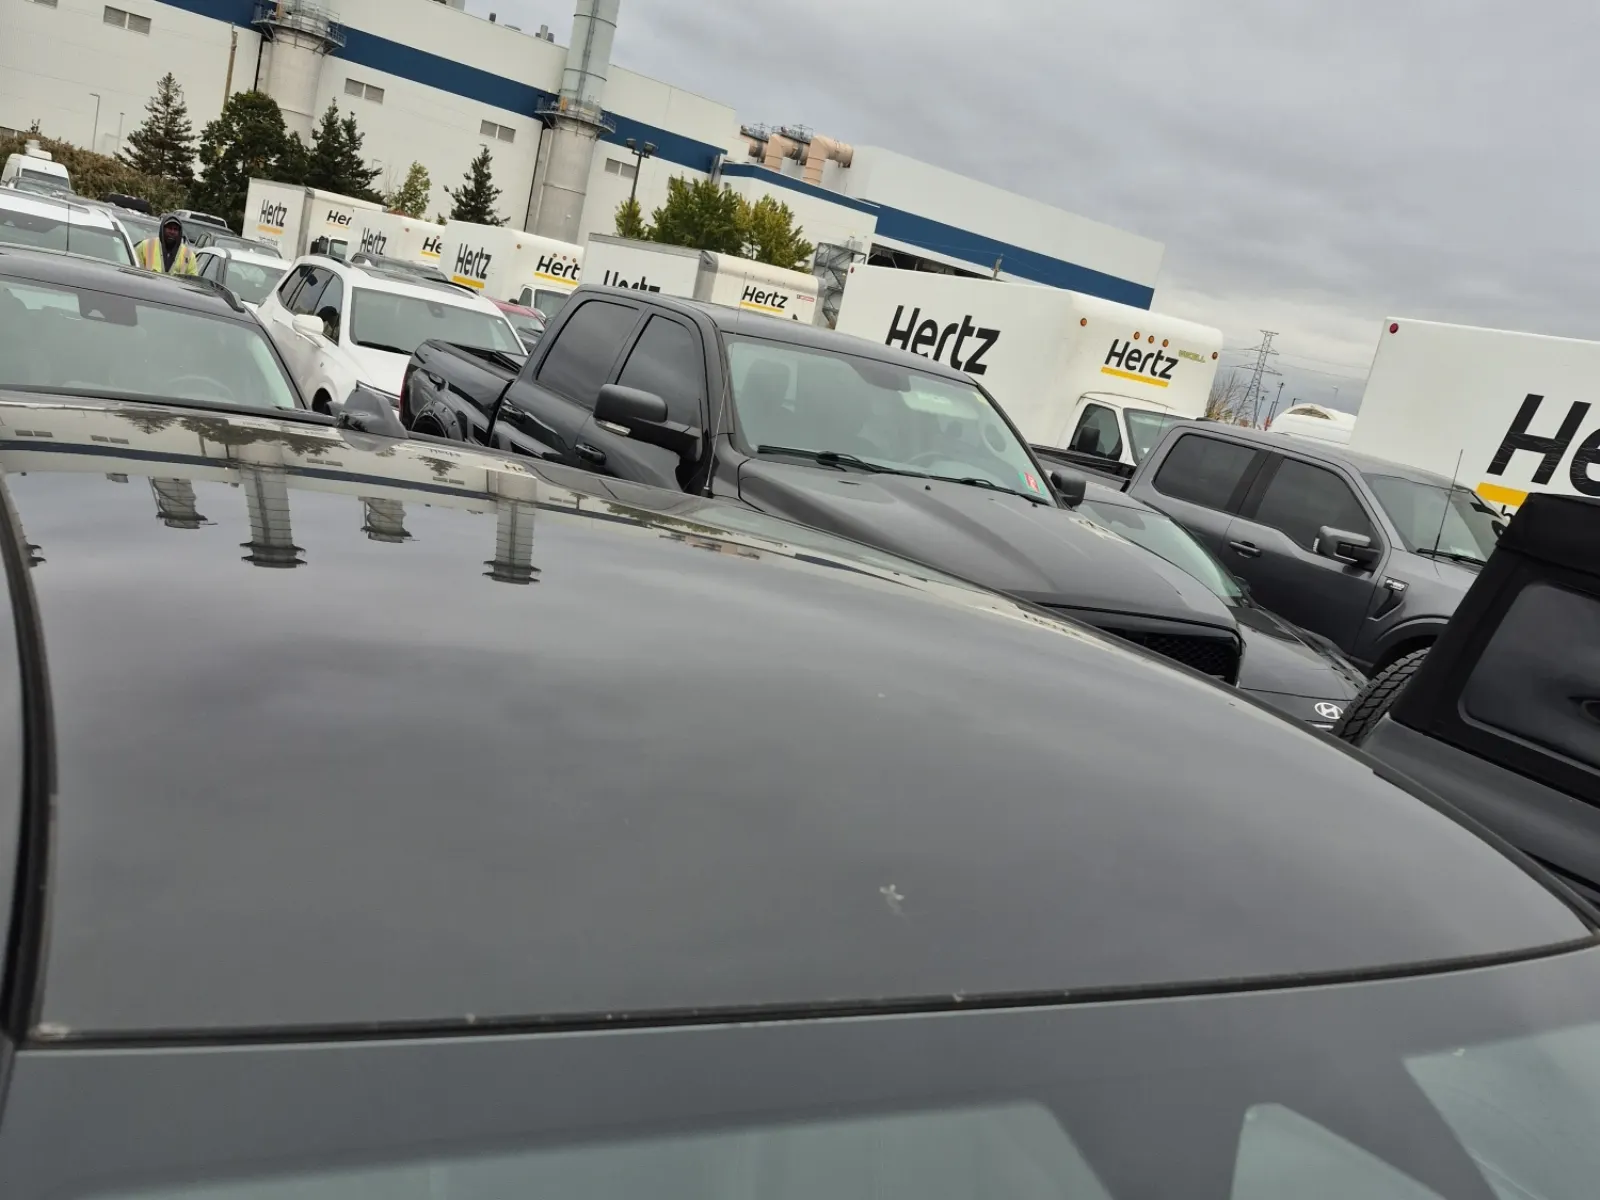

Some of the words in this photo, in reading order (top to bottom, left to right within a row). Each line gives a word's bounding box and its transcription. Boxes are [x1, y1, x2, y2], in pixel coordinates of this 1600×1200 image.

[259, 199, 287, 227] Hertz
[326, 209, 352, 226] Her
[360, 227, 387, 256] Hertz
[454, 243, 492, 280] Hertz
[536, 255, 581, 280] Hert
[742, 285, 788, 309] Hertz
[885, 305, 1001, 375] Hertz
[1104, 339, 1179, 380] Hertz
